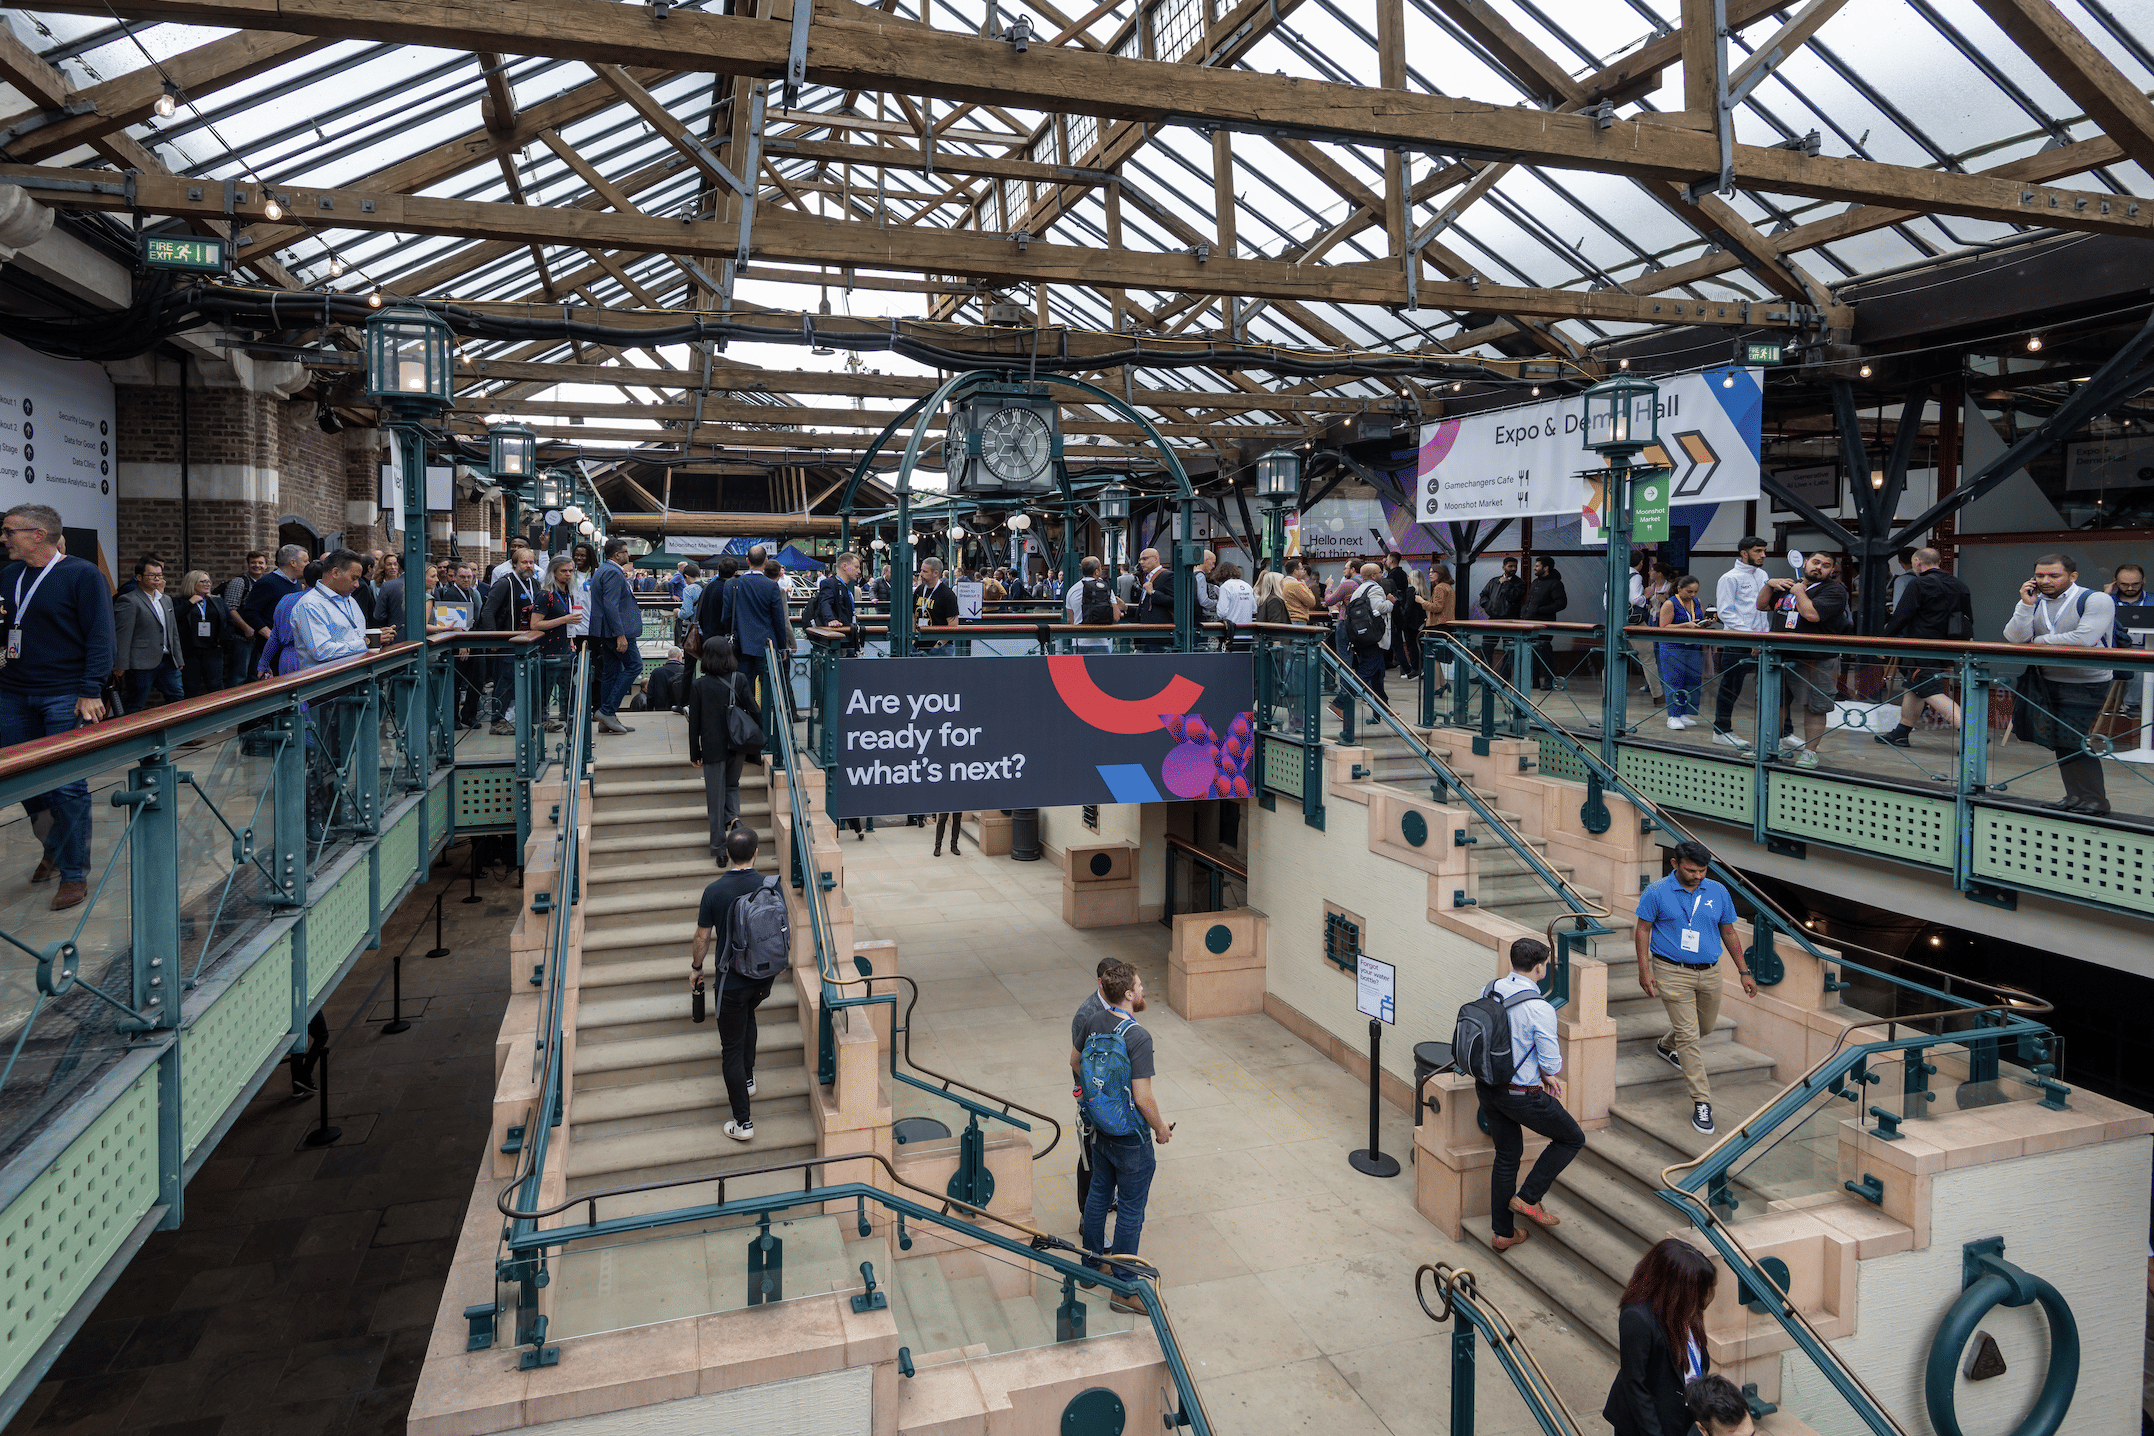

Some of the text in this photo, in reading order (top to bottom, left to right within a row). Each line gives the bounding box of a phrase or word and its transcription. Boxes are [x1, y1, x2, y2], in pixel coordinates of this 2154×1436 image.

[149, 241, 173, 251] FIRE
[149, 251, 173, 260] EXIT
[59, 411, 95, 429] Security Lounge
[1495, 425, 1539, 447] Expo
[1545, 417, 1556, 437] &
[1636, 394, 1679, 422] Hall
[14, 423, 18, 431] 2
[2, 442, 18, 455] Stage
[64, 435, 75, 445] Data
[83, 440, 95, 449] Good
[2077, 449, 2100, 457] Expo
[73, 457, 96, 469] Data Clinic
[46, 473, 67, 483] Business
[68, 477, 88, 488] Analytics
[1794, 472, 1829, 480] Generative
[1445, 476, 1514, 490] Gamechangers Cafe
[1444, 499, 1503, 510] Moonshot Market
[1310, 534, 1363, 545] Hello next
[846, 689, 960, 720] Are you
[847, 722, 982, 755] ready for
[846, 753, 1026, 786] what’s next?
[1361, 959, 1378, 970] Forgot
[1360, 968, 1389, 981] your water
